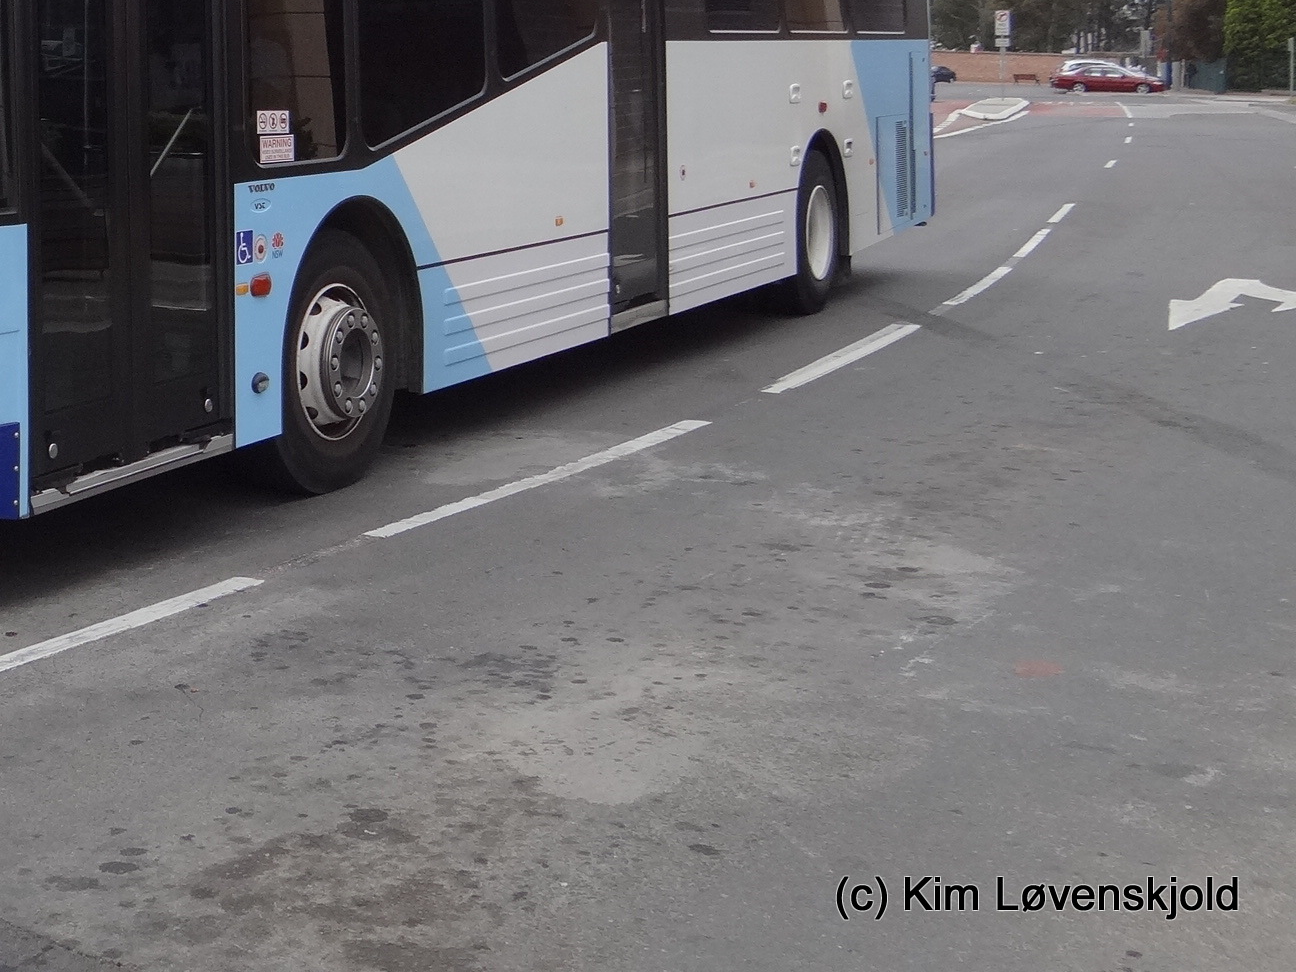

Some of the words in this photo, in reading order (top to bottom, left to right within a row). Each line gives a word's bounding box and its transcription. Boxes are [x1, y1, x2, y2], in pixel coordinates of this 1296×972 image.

[262, 138, 292, 148] WARNING
[248, 182, 275, 193] VOLVO
[272, 250, 283, 259] NSW
